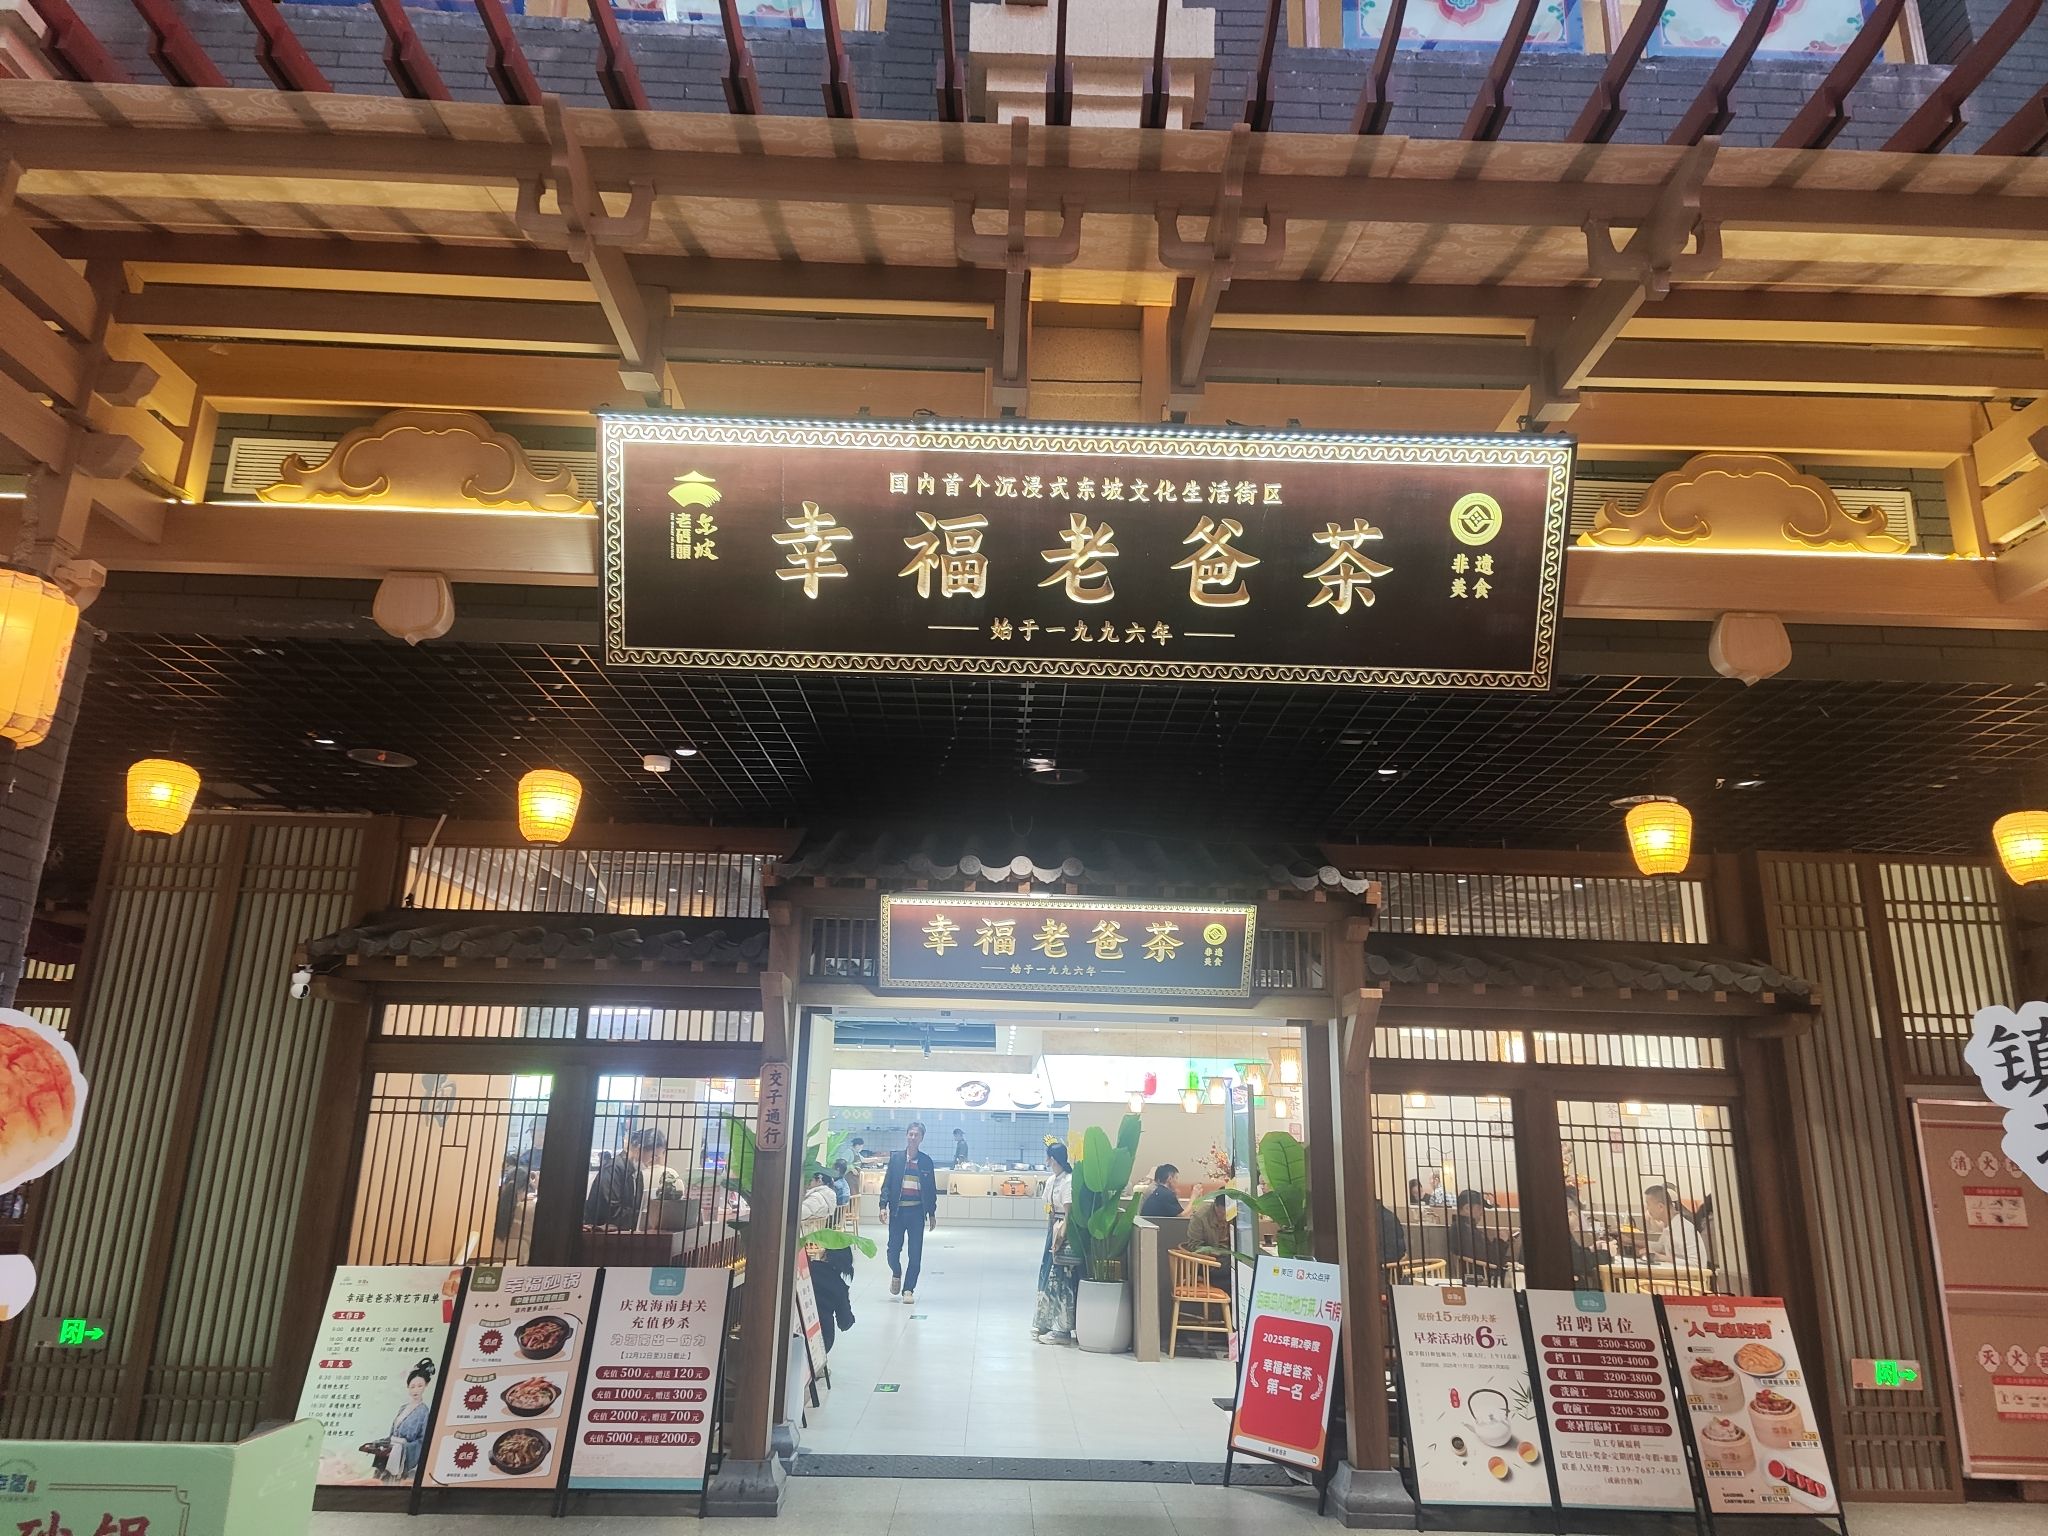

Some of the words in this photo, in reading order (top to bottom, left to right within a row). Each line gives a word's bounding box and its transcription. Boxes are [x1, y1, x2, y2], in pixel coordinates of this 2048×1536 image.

[889, 472, 1284, 506] 国内首个沉浸式东坡文化生活街区
[771, 500, 1394, 615] 幸福老爸茶
[1449, 577, 1493, 599] 美食
[990, 617, 1174, 646] 始于一九九六年
[921, 913, 1184, 963] 幸福老爸茶
[1010, 963, 1097, 977] 始于一九九六年
[764, 1070, 783, 1144] 交子通行
[504, 1272, 581, 1294] 幸福砂锅
[346, 1293, 440, 1304] 幸福老爸茶演艺节目单
[620, 1299, 707, 1312] 庆祝海南封关
[632, 1316, 690, 1329] 充值秒杀
[1557, 1315, 1634, 1334] 招聘岗位
[1263, 1333, 1321, 1353] 2025年第2季度
[1414, 1326, 1508, 1349] 早茶活动价6元
[1597, 1339, 1647, 1350] 3500-4500
[1263, 1359, 1312, 1380] 幸福老爸茶
[1600, 1355, 1650, 1366] 3200-4000
[1603, 1372, 1653, 1383] 3200-3800
[1266, 1378, 1303, 1400] 第一名
[1606, 1389, 1657, 1400] 3200-3800
[1609, 1406, 1660, 1417] 3200-3800
